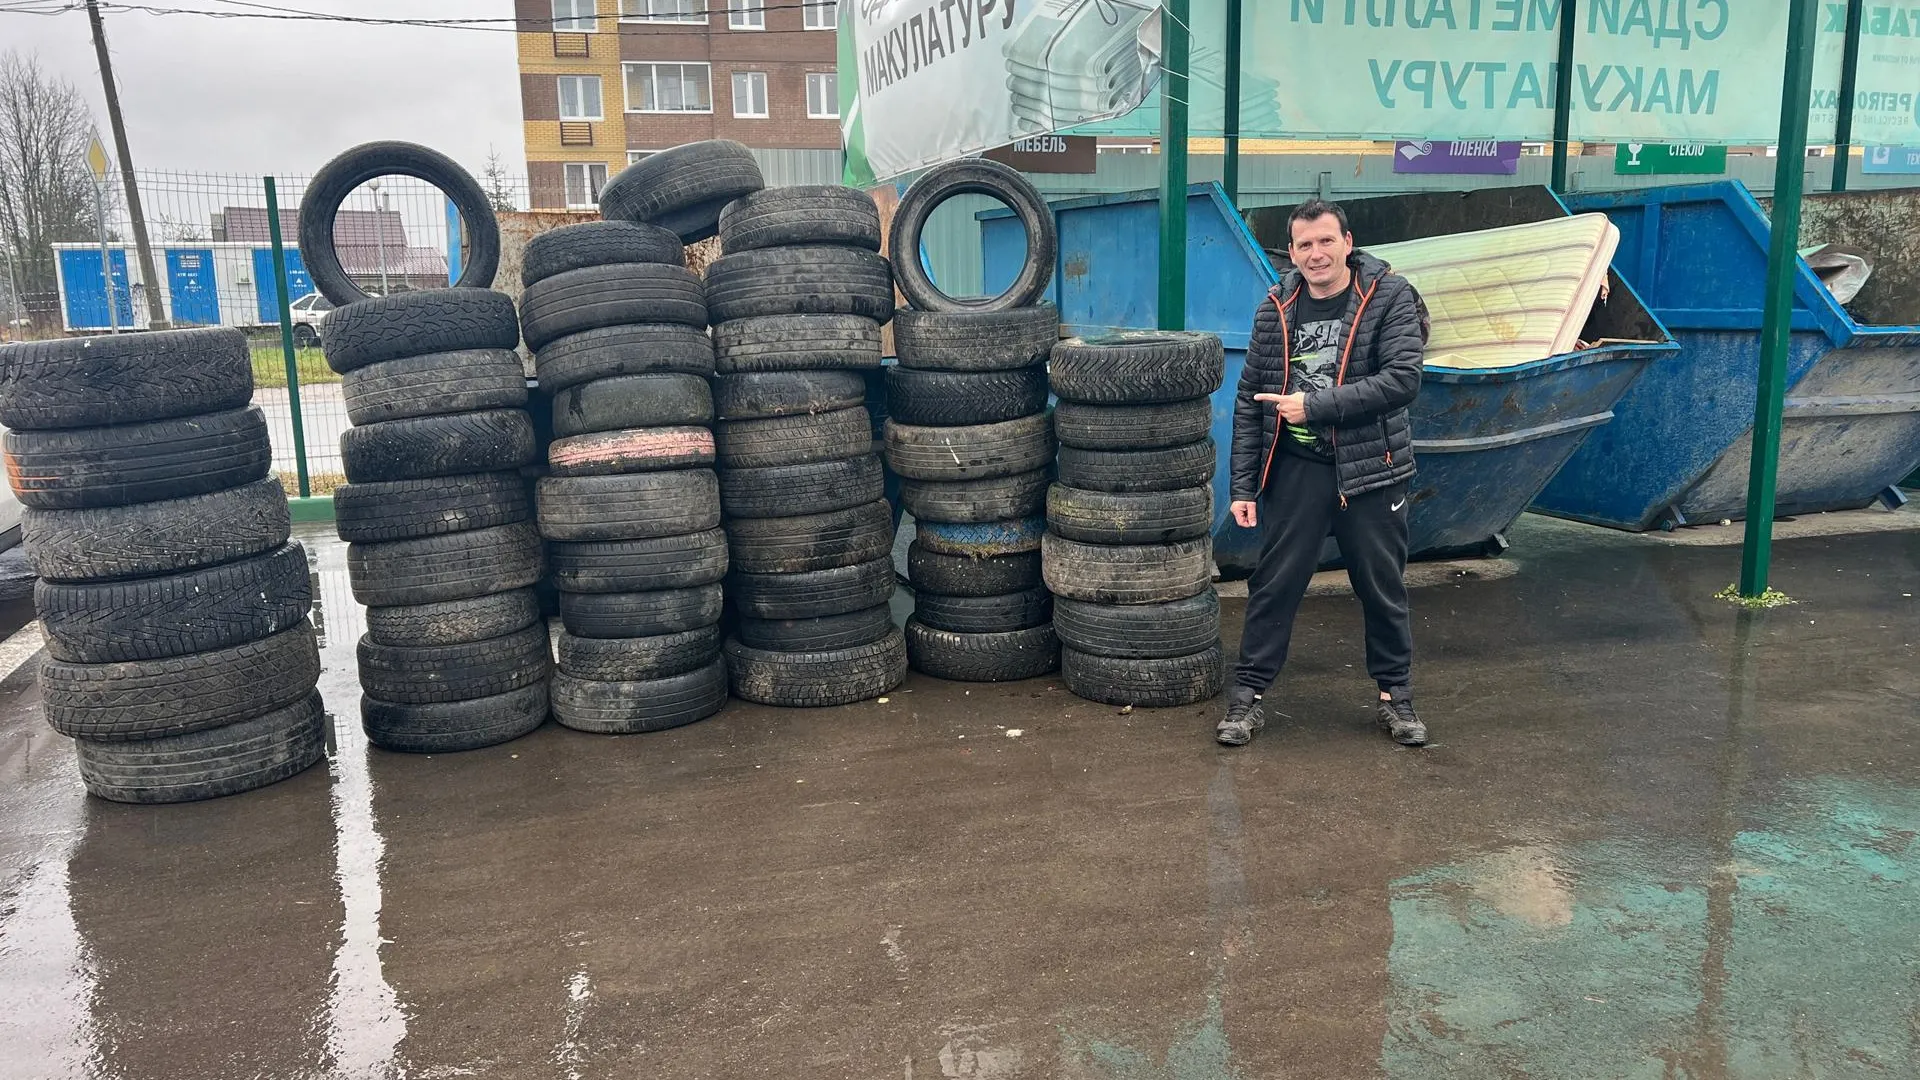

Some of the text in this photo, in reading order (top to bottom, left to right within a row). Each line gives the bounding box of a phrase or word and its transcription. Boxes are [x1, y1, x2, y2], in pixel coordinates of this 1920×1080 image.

[864, 0, 1015, 97] МАКУЛАТУРУ
[1013, 136, 1067, 152] МЕБЕЛЬ
[1449, 141, 1498, 156] ПЛЕНКА
[1669, 144, 1705, 157] СТЕКЛО
